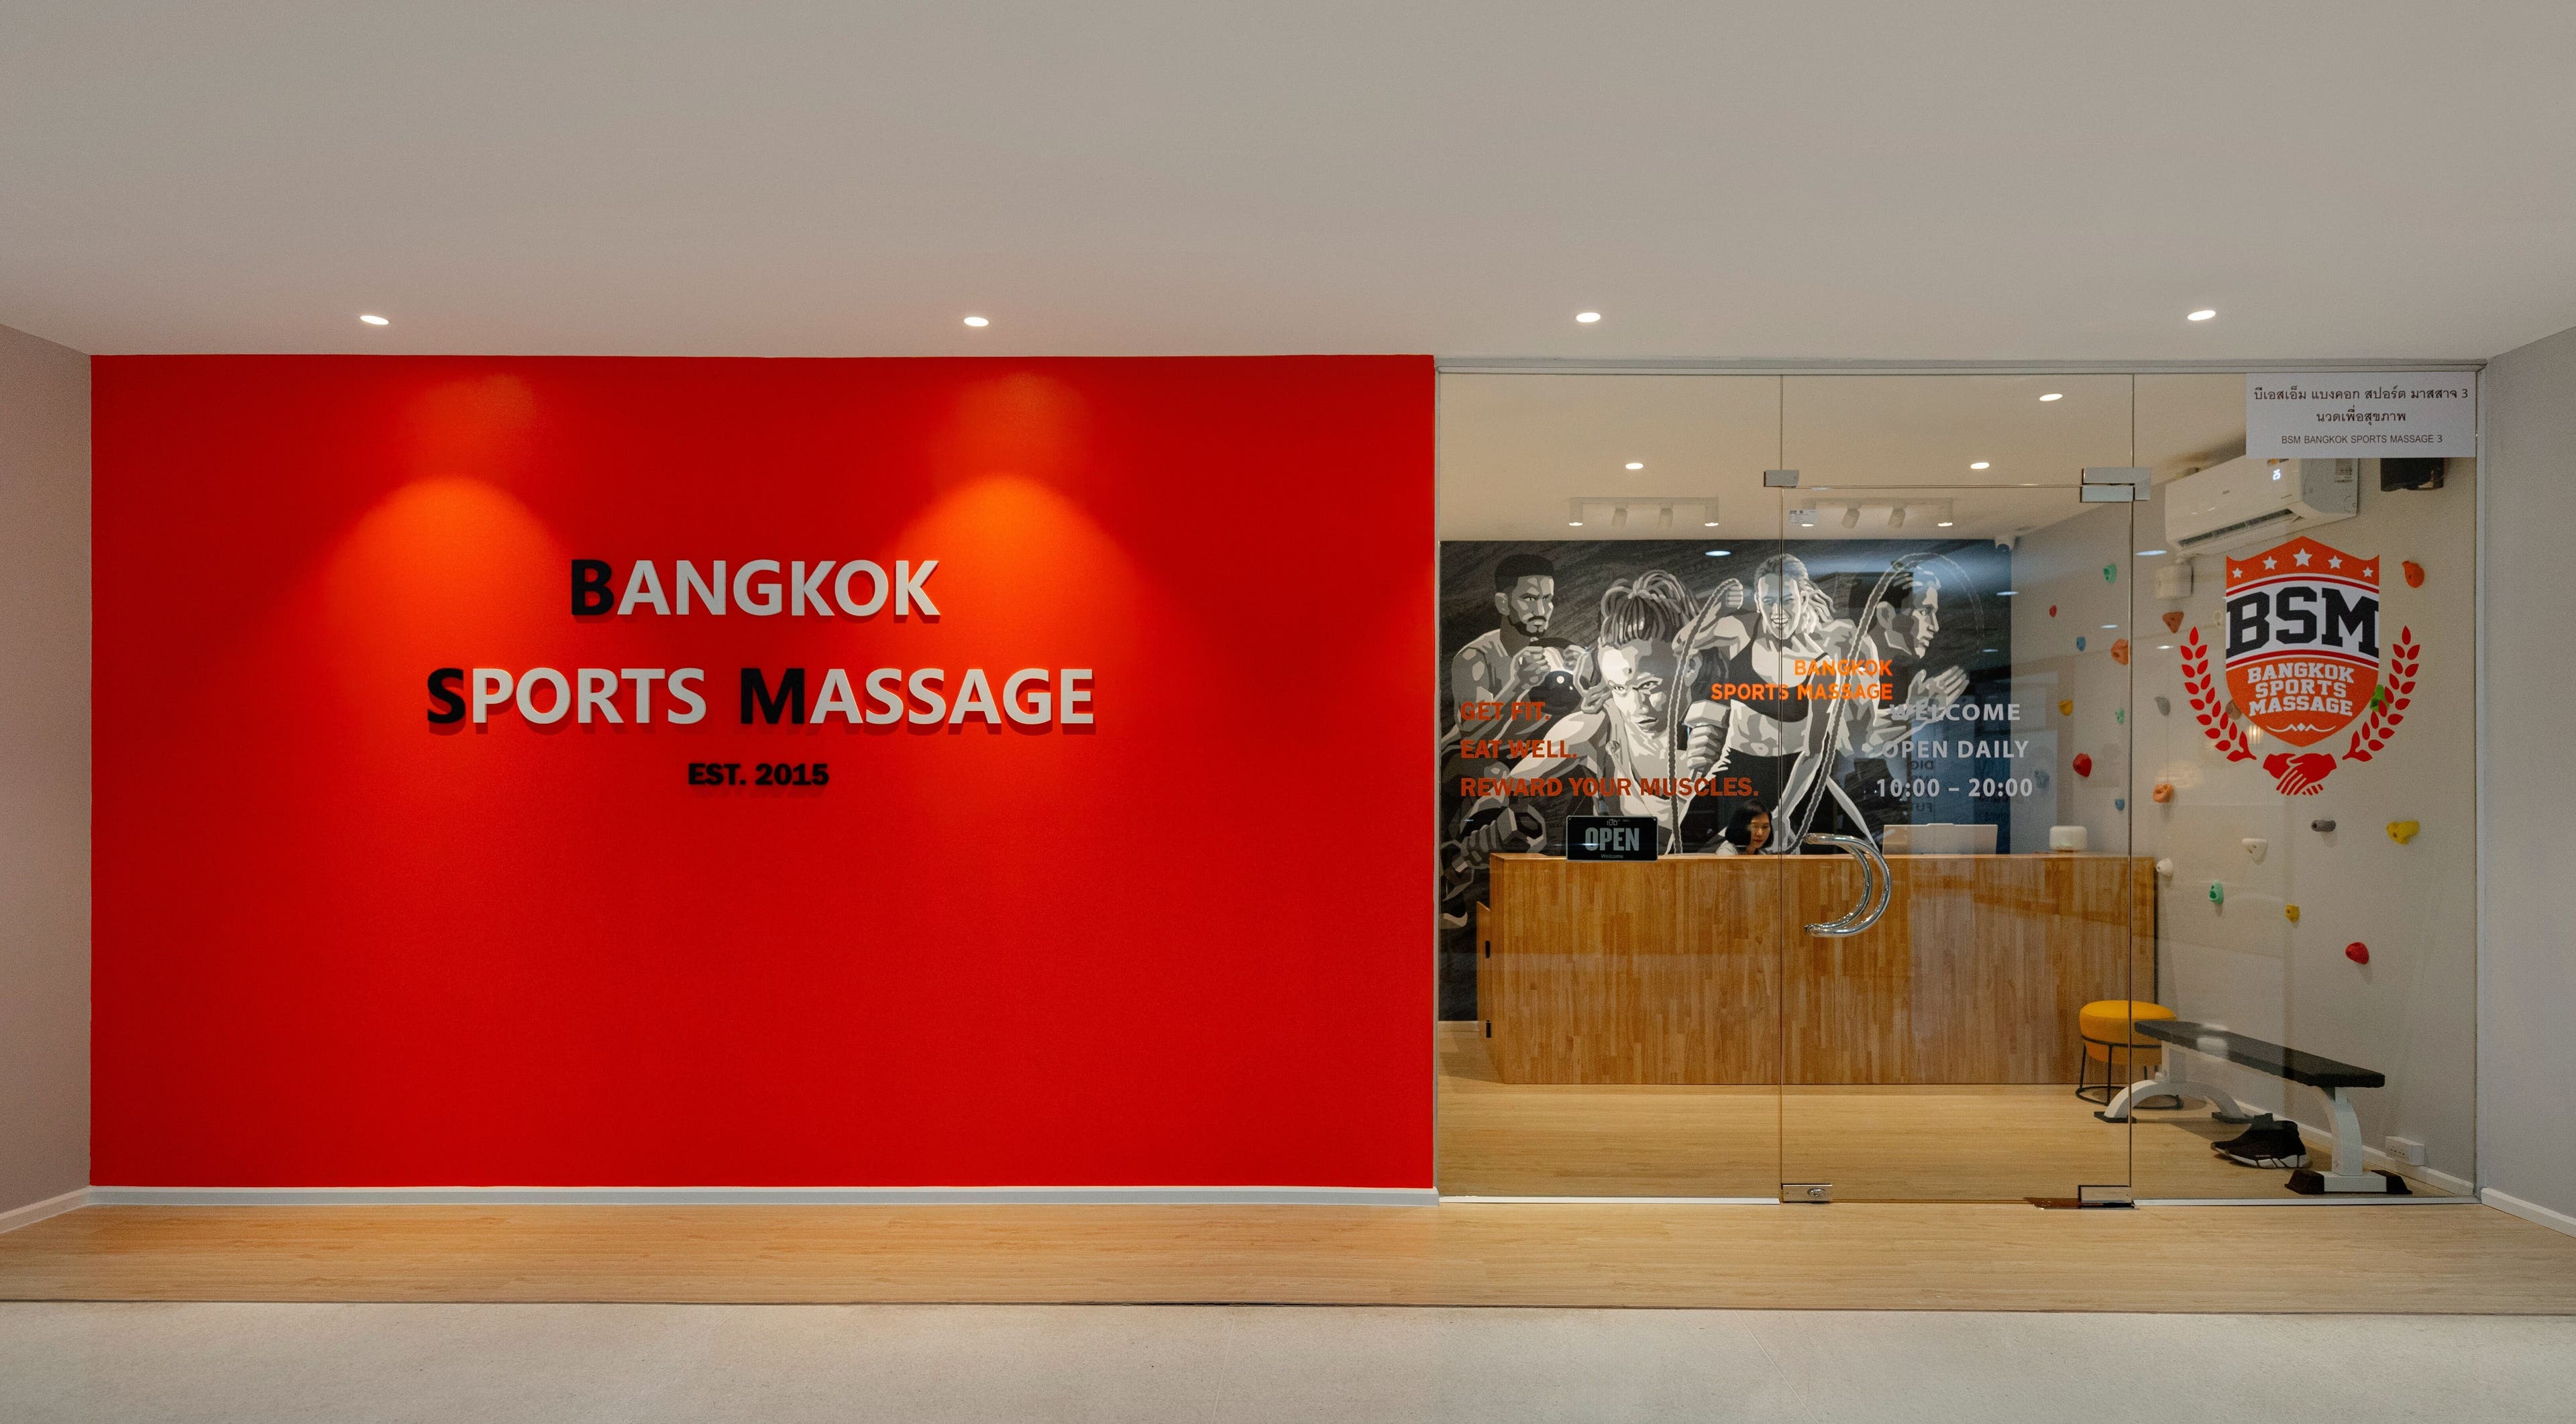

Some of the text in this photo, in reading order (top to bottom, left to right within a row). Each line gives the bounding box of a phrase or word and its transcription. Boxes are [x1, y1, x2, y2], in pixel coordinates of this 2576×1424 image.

[2254, 385, 2469, 400] บีเอสเอ็ม แบงคอก สปอร์ต มาสสาจ 3
[2316, 405, 2406, 425] นวดเพื่อสุขภาพ
[2282, 435, 2443, 444] BSM BANGKOK SPORTS MASSAGE 3
[571, 559, 941, 616] BANGKOK
[2226, 586, 2379, 659] BSM
[1794, 659, 1893, 676] BANGKOK
[2247, 663, 2355, 683] BANGKOK
[427, 667, 1093, 725] SPORTS MASSAGE
[1711, 683, 1893, 700] SPORTS MASSAGE
[2255, 679, 2347, 698] SPORTS
[1460, 702, 1550, 721] GET FIT.
[1890, 704, 2021, 721] WELCOME
[2249, 696, 2353, 716] MASSAGE
[1460, 740, 1577, 759] EAT WELL.
[1882, 741, 2029, 758] OPEN DAILY
[688, 763, 830, 787] EST. 2015
[1461, 778, 1759, 797] REWARD YOUR MUSCLES.
[1877, 778, 1940, 797] 10:00
[1968, 778, 2033, 797] 20:00
[1585, 827, 1640, 852] OPEN
